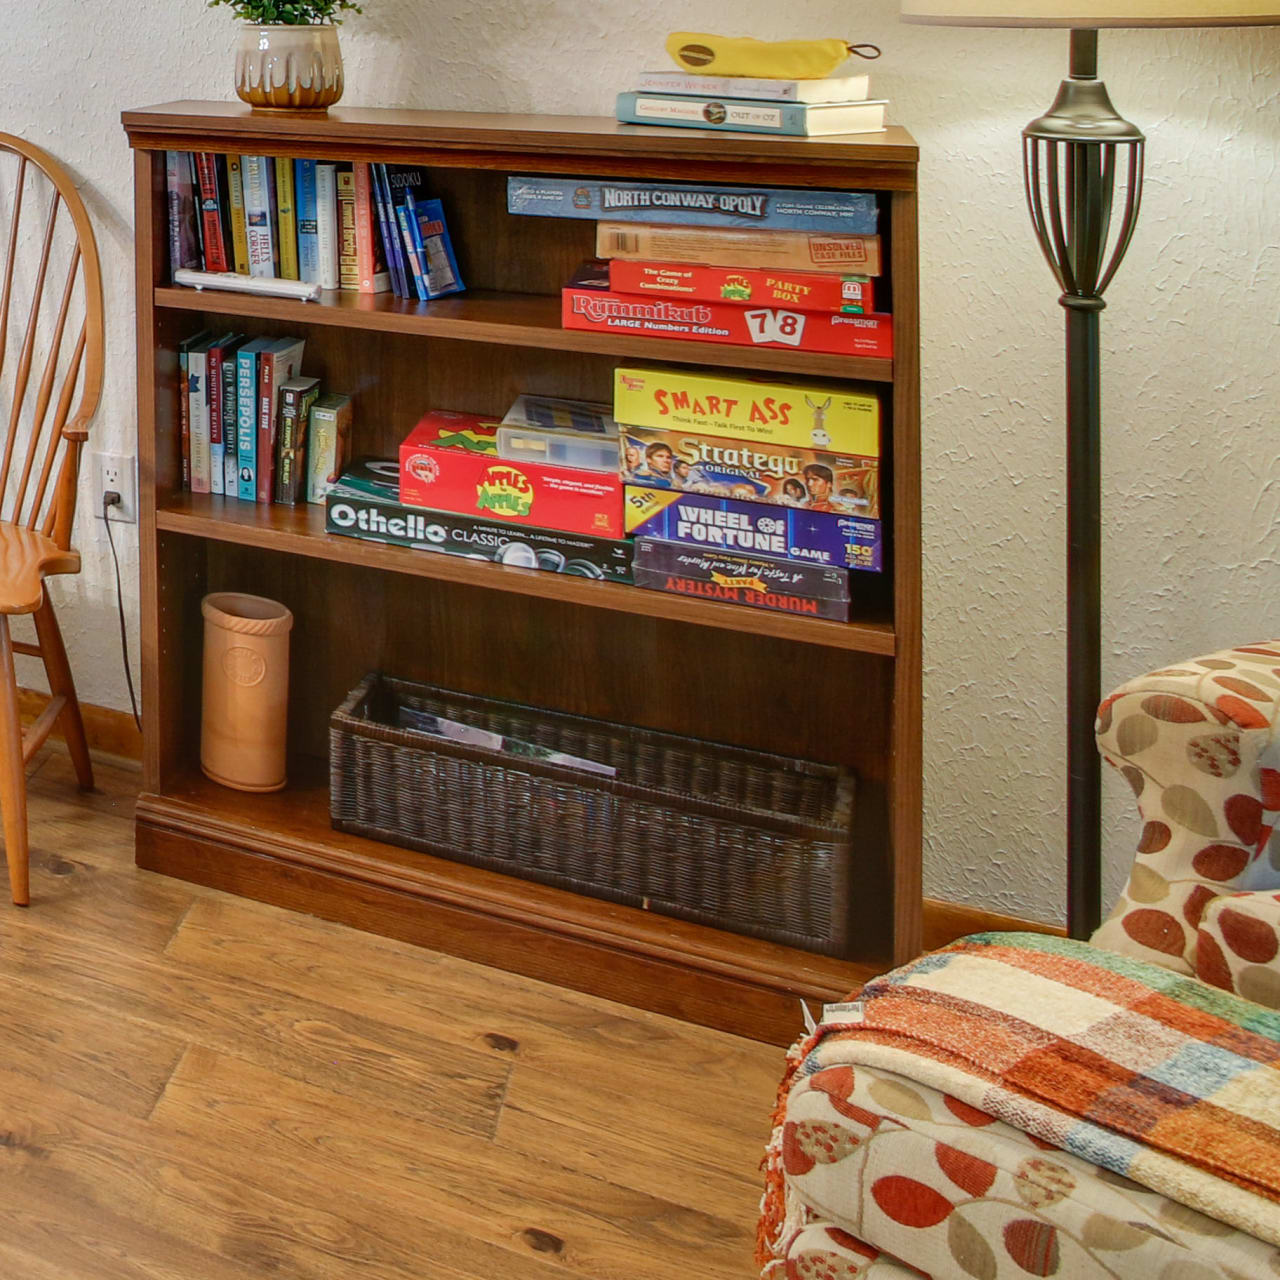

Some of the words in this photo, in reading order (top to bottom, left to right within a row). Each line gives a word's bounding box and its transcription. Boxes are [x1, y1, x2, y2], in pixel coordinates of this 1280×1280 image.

[730, 111, 749, 120] OUT
[762, 114, 776, 122] OZ
[391, 172, 421, 187] SUDOKU
[604, 188, 650, 207] NORTH
[248, 230, 260, 265] CORNER
[259, 233, 271, 263] HELL'S
[813, 242, 862, 252] UNSOLVED
[815, 251, 837, 259] CASE
[656, 276, 679, 285] Crazy
[659, 270, 682, 278] Game
[765, 278, 812, 296] PARTY
[772, 289, 801, 303] BOX
[573, 295, 712, 324] Rummikub
[608, 318, 641, 328] LARGE
[644, 321, 689, 332] Numbers
[692, 326, 729, 336] Edition
[750, 313, 767, 333] 7
[779, 315, 798, 336] 8
[211, 401, 217, 409] IN
[239, 358, 251, 451] PERSEPOLIS
[654, 389, 738, 418] SMART
[749, 397, 792, 425] ASS
[672, 415, 691, 423] Think
[714, 421, 728, 429] Talk
[226, 426, 234, 453] LIMITS
[678, 437, 802, 479] Stratego
[478, 465, 530, 493] APPLES
[705, 463, 762, 480] ORIGINAL
[477, 488, 531, 516] APPLES
[631, 492, 656, 508] 5th
[330, 504, 445, 543] Othello
[677, 505, 752, 531] WHEEL
[757, 517, 785, 535] OF
[452, 528, 510, 548] CLASSIC
[677, 522, 787, 553] FORTUNE
[790, 547, 831, 562] GAME
[844, 543, 872, 556] 150
[676, 554, 711, 570] Murder
[711, 560, 726, 571] and
[725, 562, 748, 576] Wine
[748, 565, 763, 578] for
[762, 568, 790, 583] Taste
[792, 573, 803, 583] A
[664, 576, 738, 601] MYSTERY
[723, 578, 754, 586] PARTY
[744, 590, 818, 614] MURDER
